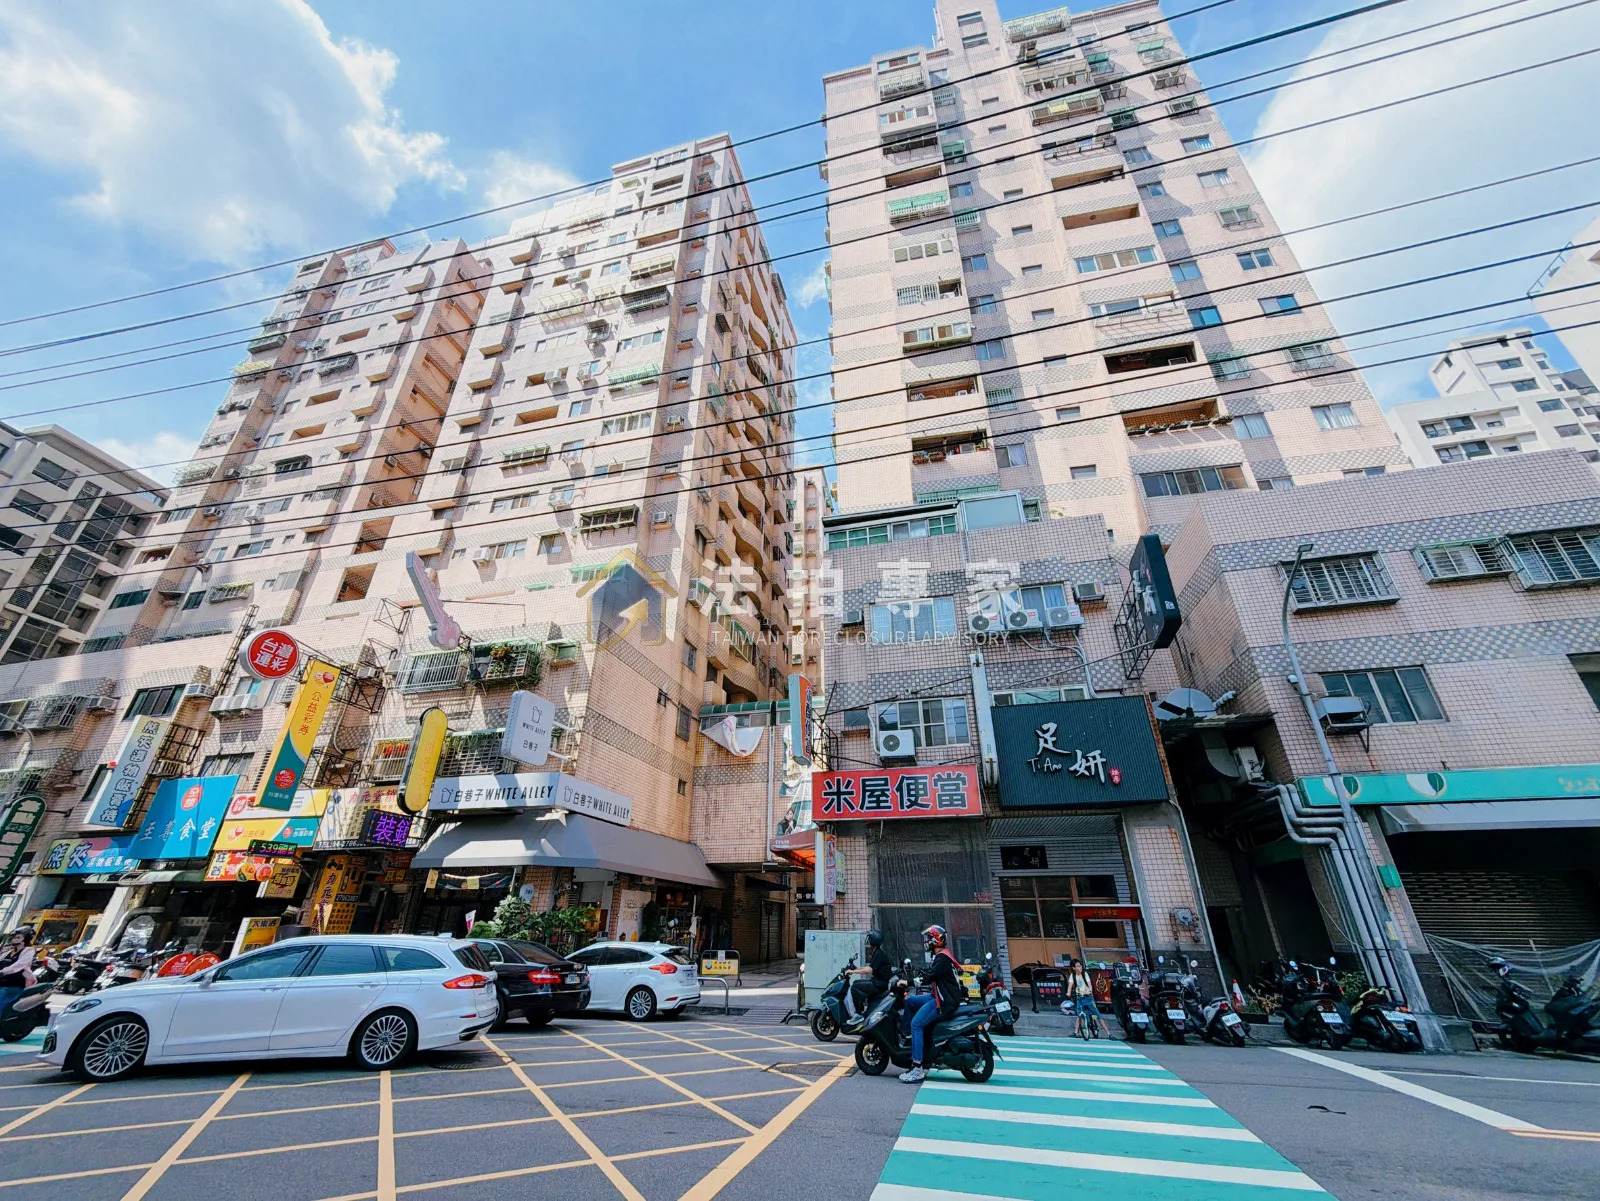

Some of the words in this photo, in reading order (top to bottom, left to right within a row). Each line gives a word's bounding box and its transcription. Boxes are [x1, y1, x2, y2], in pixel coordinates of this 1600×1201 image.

[261, 638, 294, 660] 台灣
[253, 651, 289, 673] 運彩
[297, 691, 322, 736] 公益彩券
[1027, 757, 1041, 773] Ti
[1043, 757, 1063, 773] Amo
[453, 788, 484, 804] 白巷子
[485, 786, 518, 802] WHITE
[520, 785, 554, 800] ALLEY
[822, 770, 969, 815] 米屋便當
[572, 792, 593, 809] 白巷子
[593, 797, 613, 814] WHITE
[612, 802, 630, 820] ALLEY
[140, 816, 216, 842] 至尊食堂
